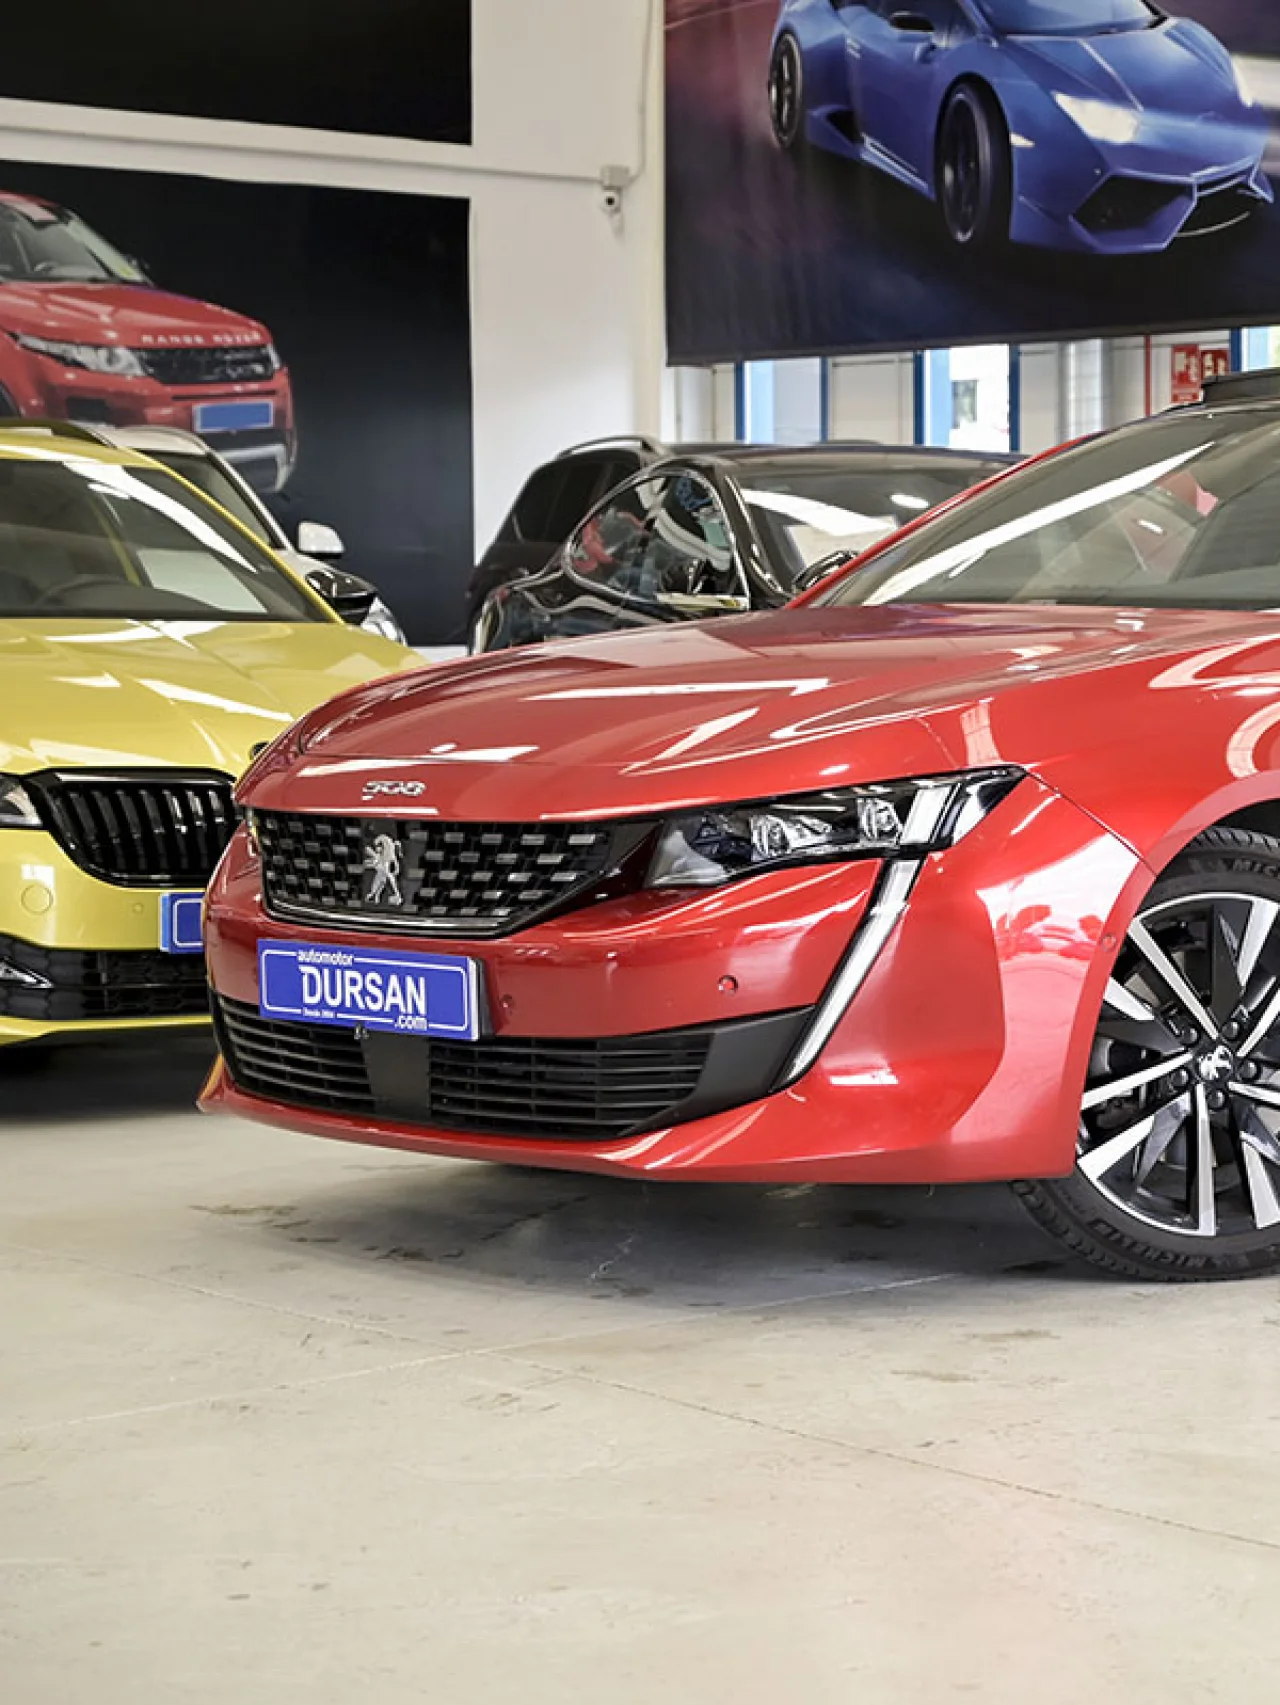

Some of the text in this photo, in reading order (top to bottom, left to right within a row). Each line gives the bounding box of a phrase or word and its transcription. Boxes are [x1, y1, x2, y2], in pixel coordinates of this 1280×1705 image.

[298, 949, 354, 968] automotor
[298, 965, 427, 1015] DURSAN
[394, 1015, 428, 1032] .com
